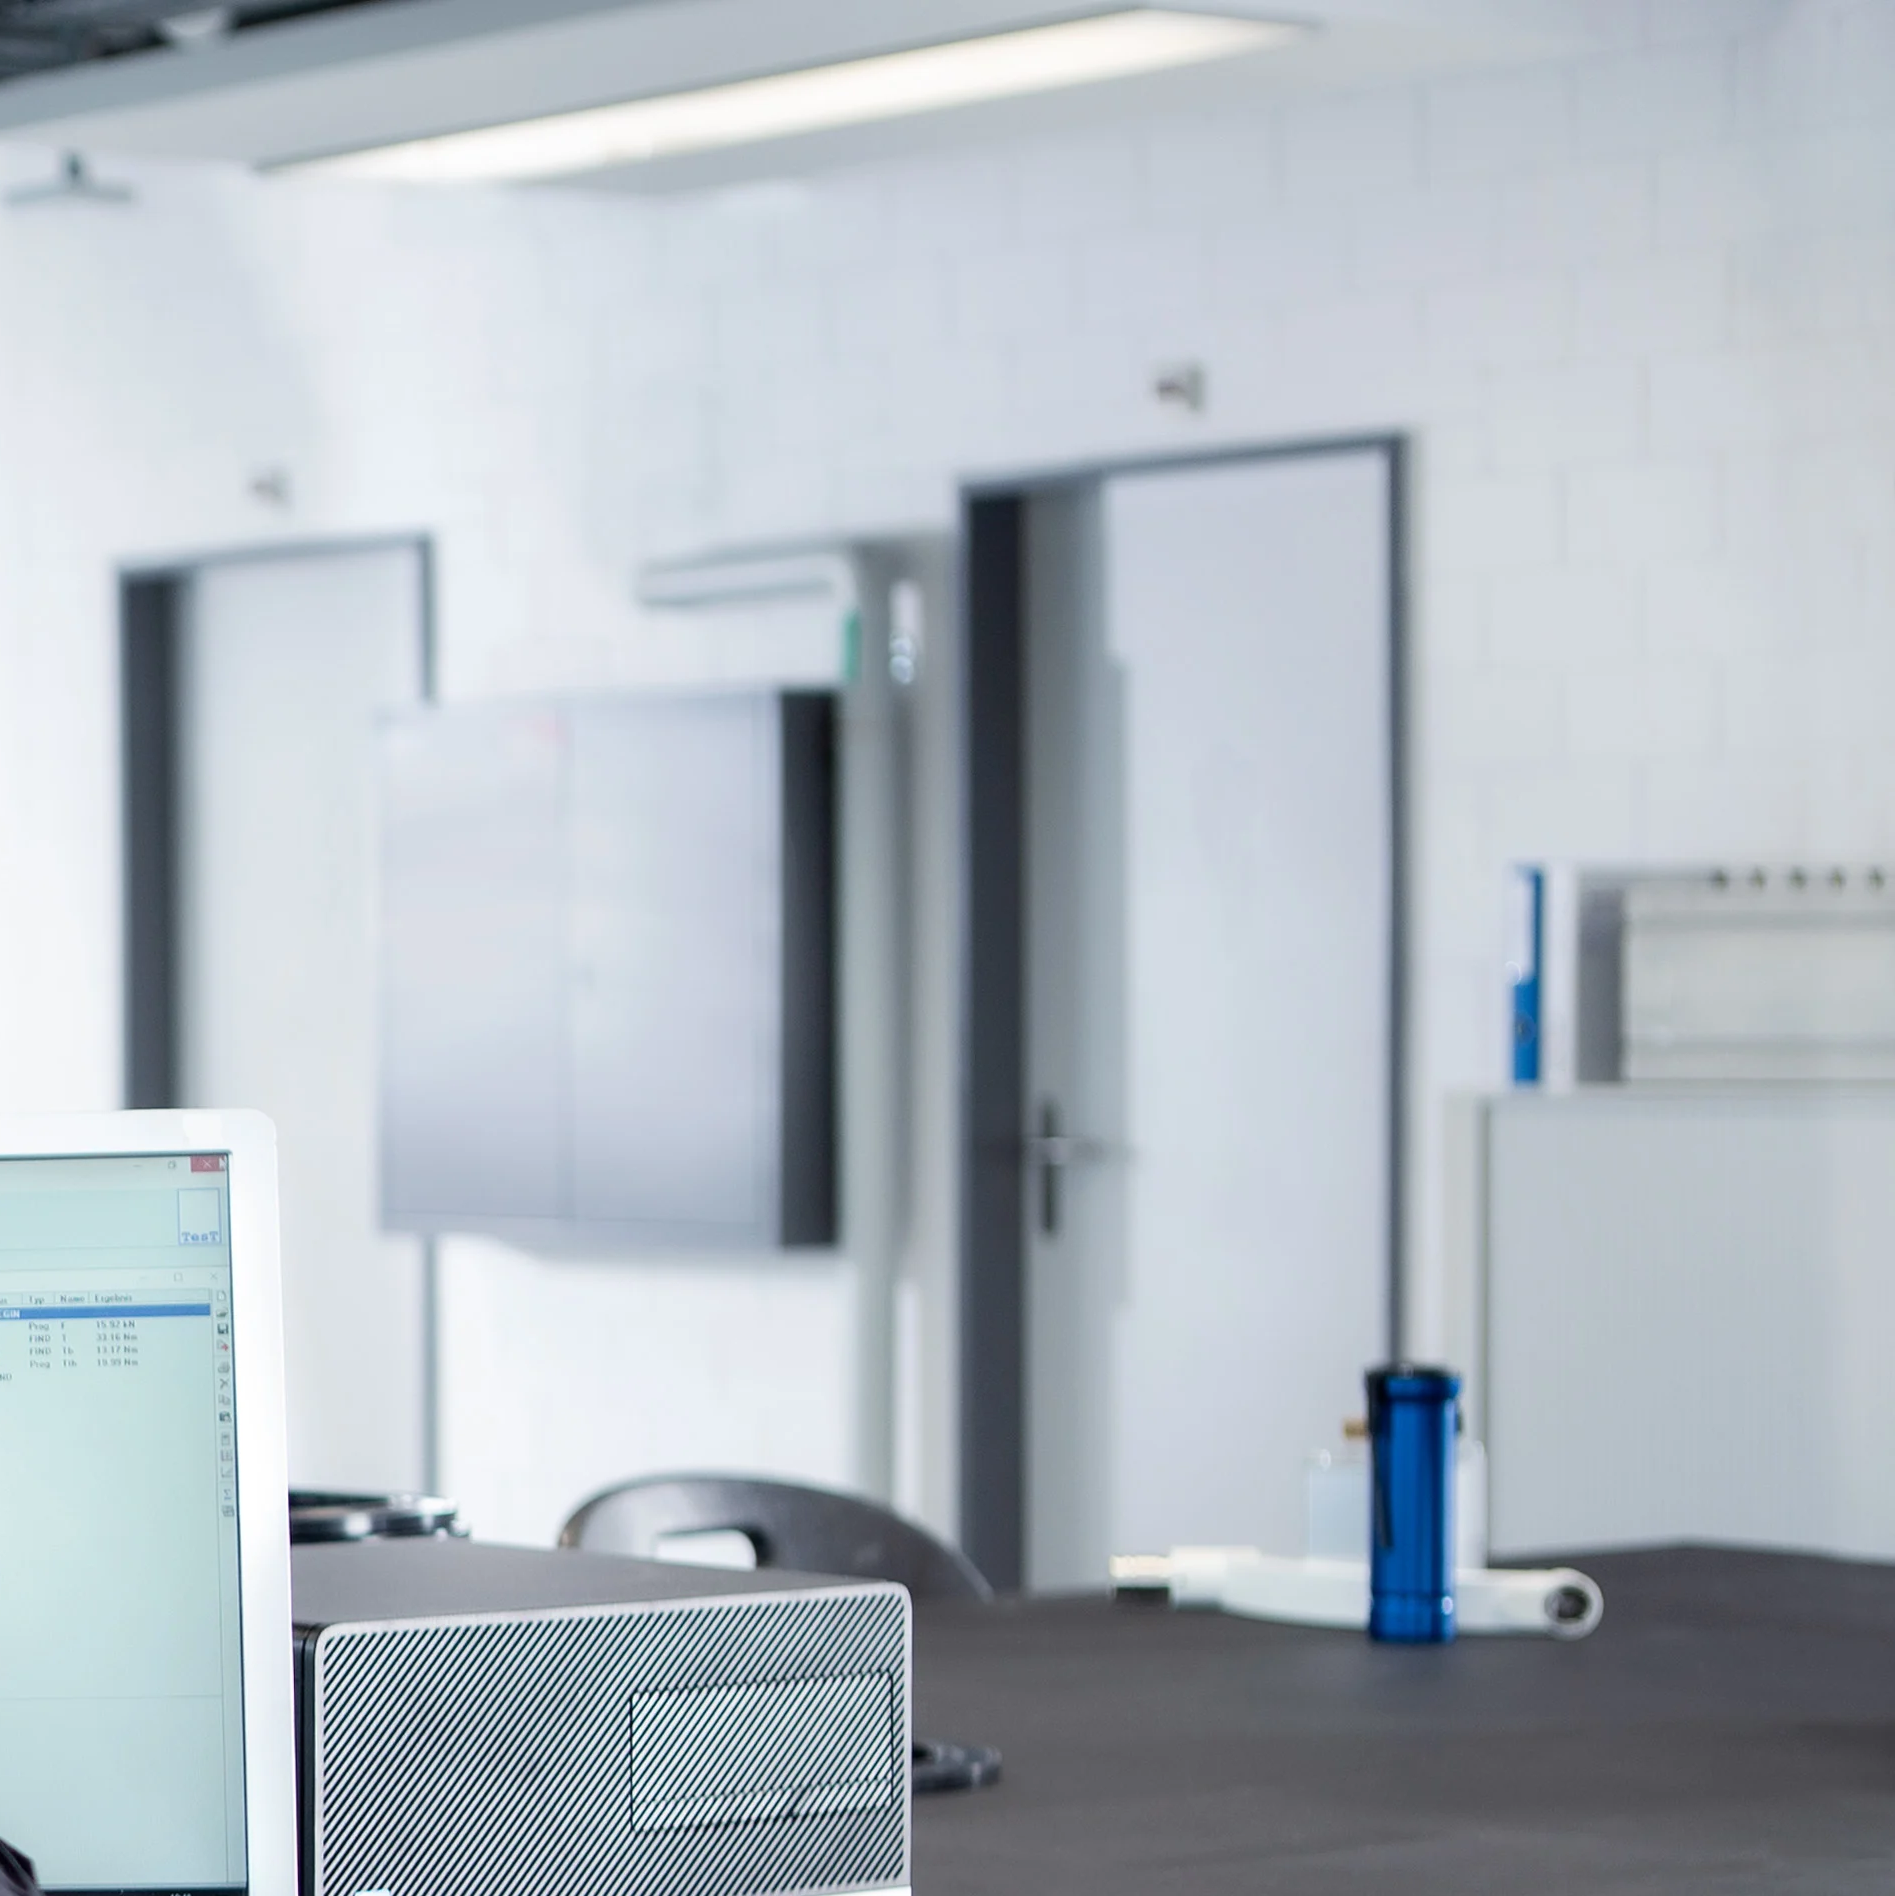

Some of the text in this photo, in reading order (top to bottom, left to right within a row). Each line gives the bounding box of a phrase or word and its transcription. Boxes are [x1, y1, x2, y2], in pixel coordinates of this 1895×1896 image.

[181, 1230, 219, 1242] TesT
[28, 1296, 45, 1306] Typ
[59, 1294, 85, 1304] Name
[95, 1293, 133, 1304] Ergebnis
[28, 1322, 50, 1332] Prog
[29, 1334, 51, 1344] FIND
[123, 1332, 138, 1342] Nm
[29, 1346, 52, 1356] FIND
[123, 1345, 139, 1354] Nm
[29, 1360, 51, 1370] Prog
[123, 1358, 139, 1368] Nm
